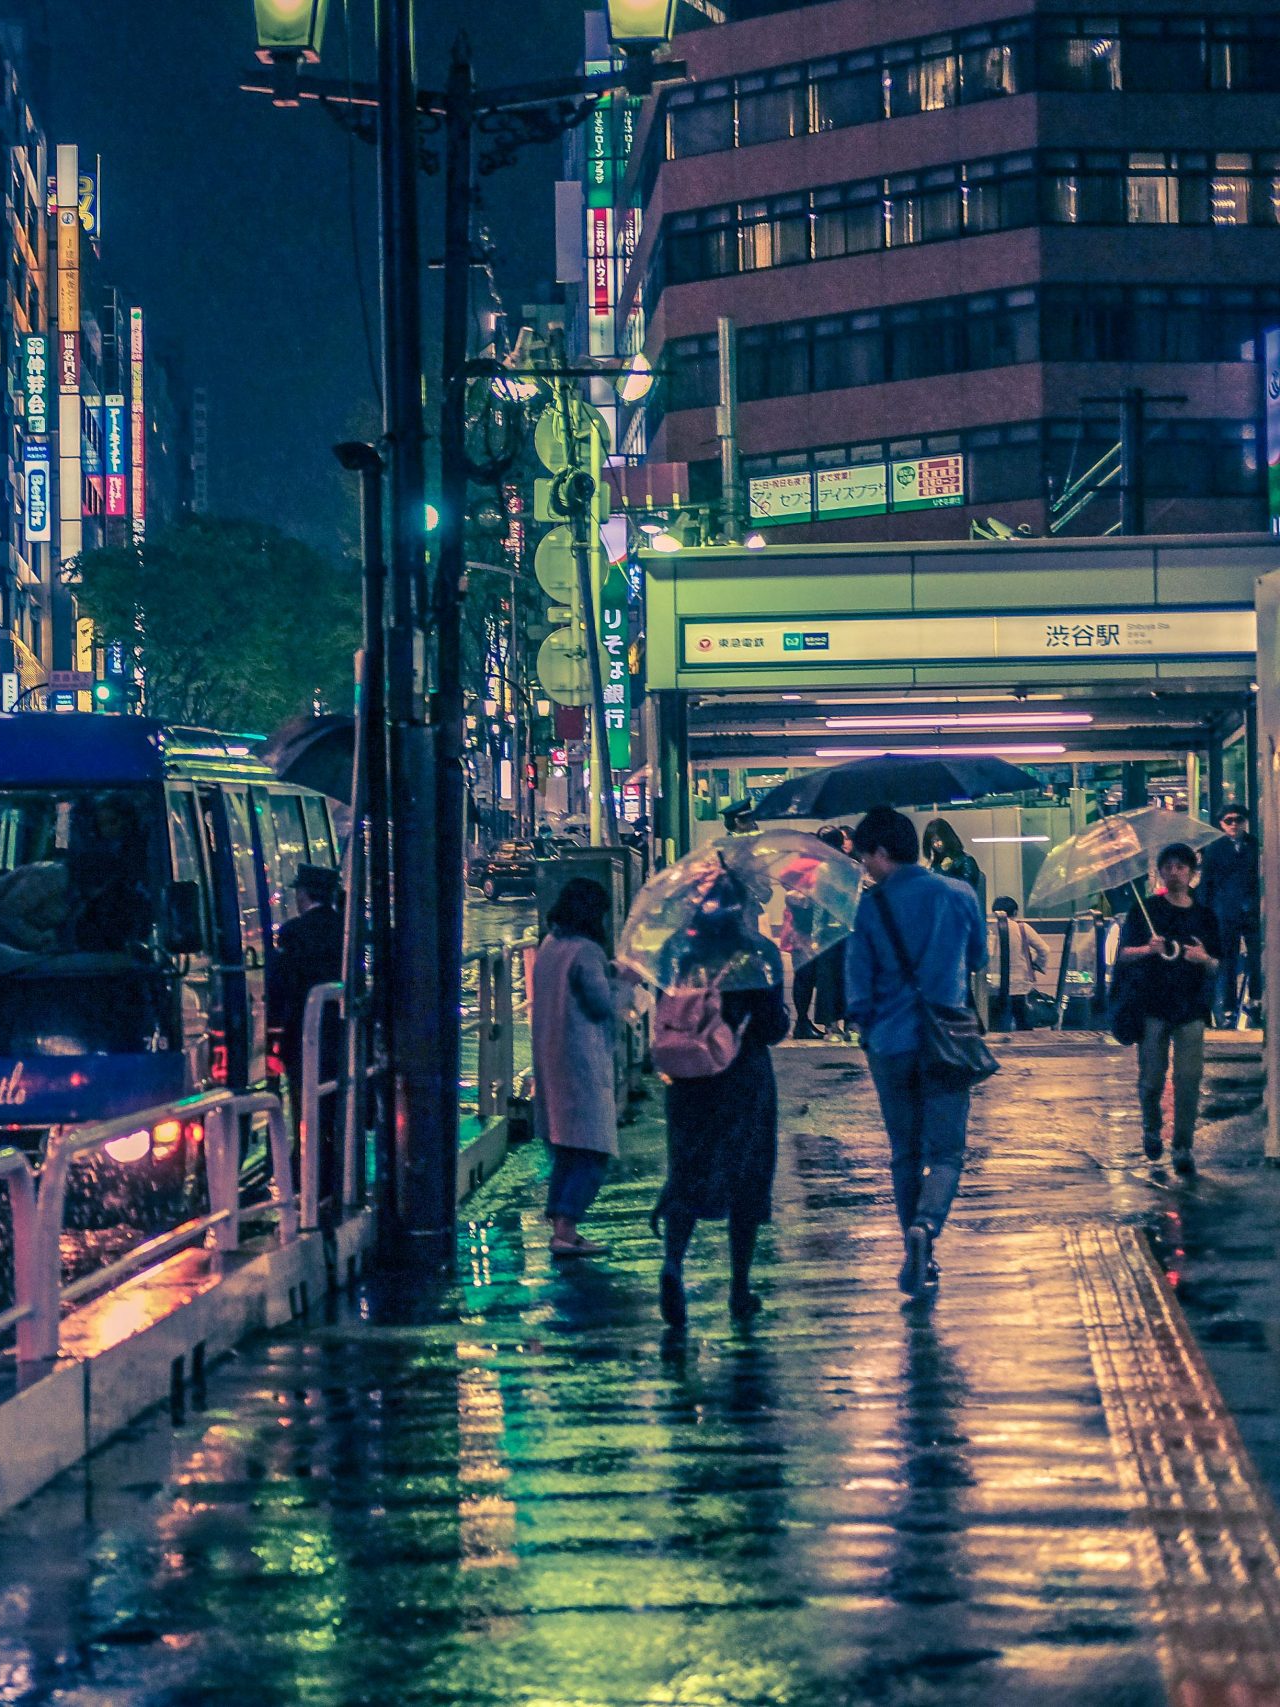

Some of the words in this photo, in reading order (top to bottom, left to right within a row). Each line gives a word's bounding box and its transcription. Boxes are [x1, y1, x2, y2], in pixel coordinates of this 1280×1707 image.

[595, 220, 606, 287] 三井のリハウス
[30, 474, 47, 527] Berlitz
[1046, 624, 1120, 647] 渋谷駅
[603, 609, 625, 729] りそな銀行
